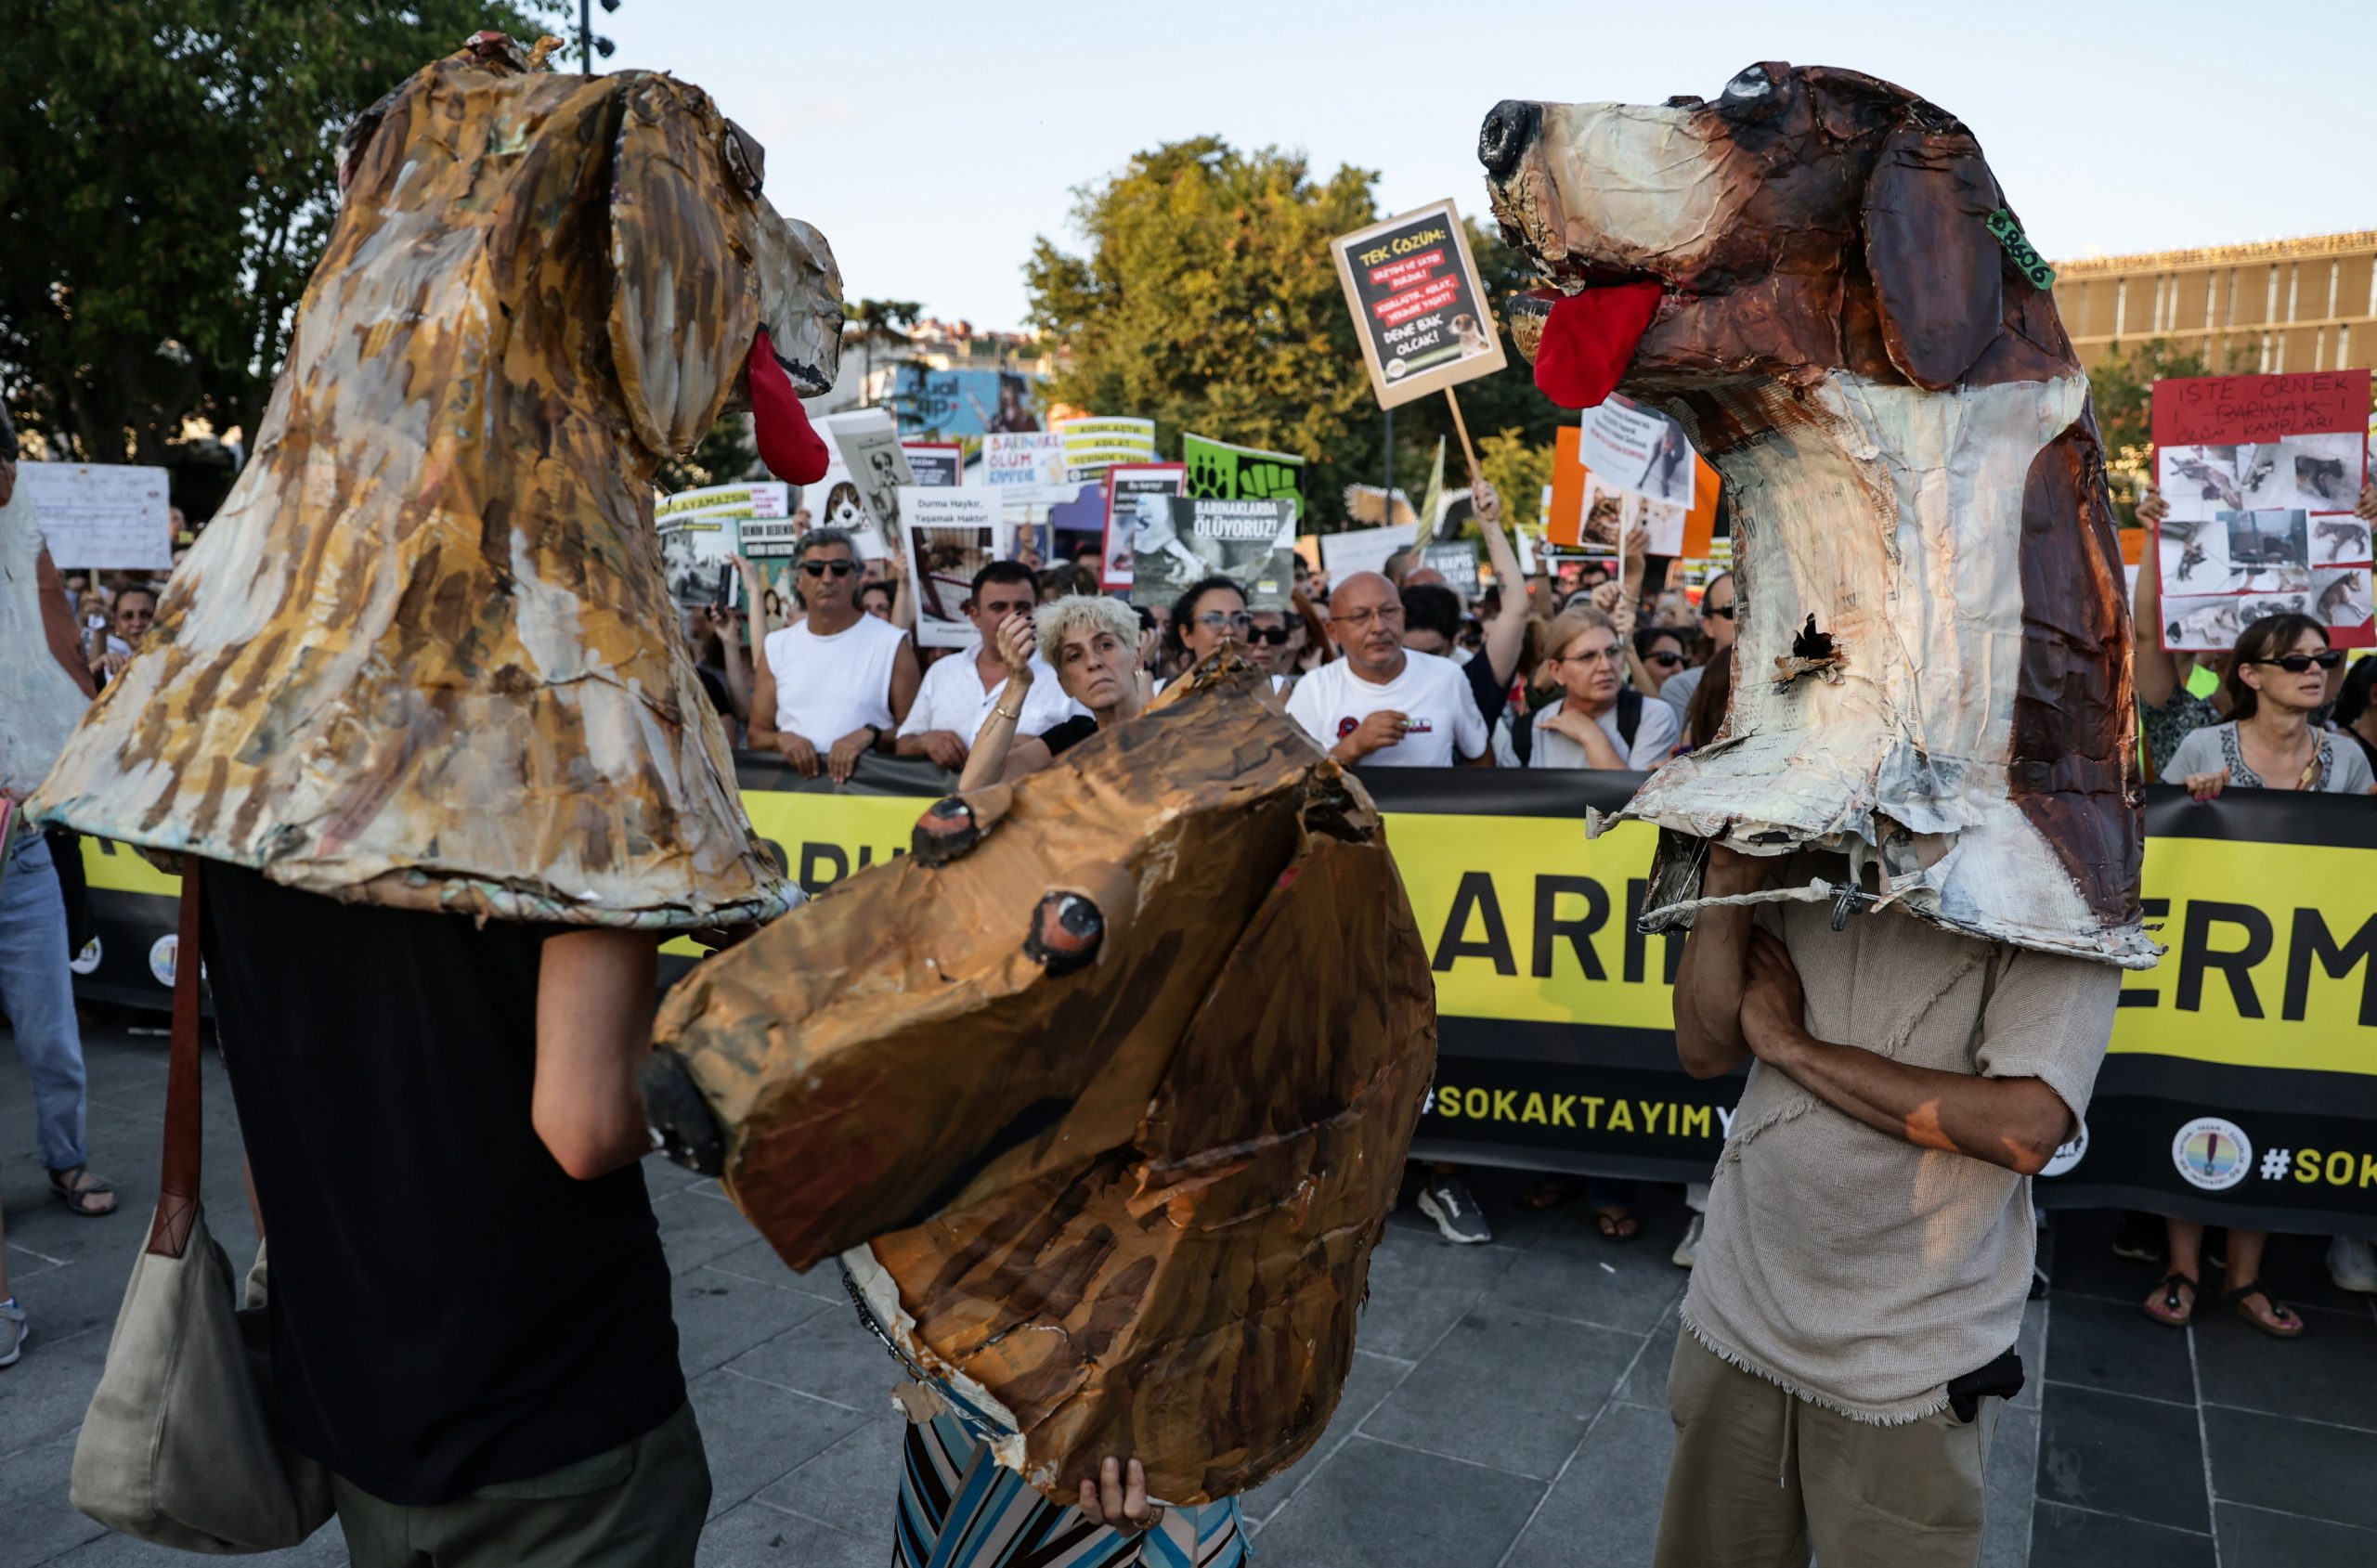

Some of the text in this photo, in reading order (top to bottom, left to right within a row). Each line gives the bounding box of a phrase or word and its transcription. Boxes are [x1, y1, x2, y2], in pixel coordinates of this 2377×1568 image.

[1359, 246, 1391, 267] TEK
[1383, 313, 1444, 344] DENE BAK
[1396, 330, 1440, 356] OLCAK!
[2242, 415, 2333, 435] KAMPLARI
[917, 499, 948, 508] Durma
[1194, 500, 1279, 515] BARINAKLARDA
[915, 515, 955, 524] Yaşamak
[1193, 514, 1278, 537] ÖLÜYORUZ!
